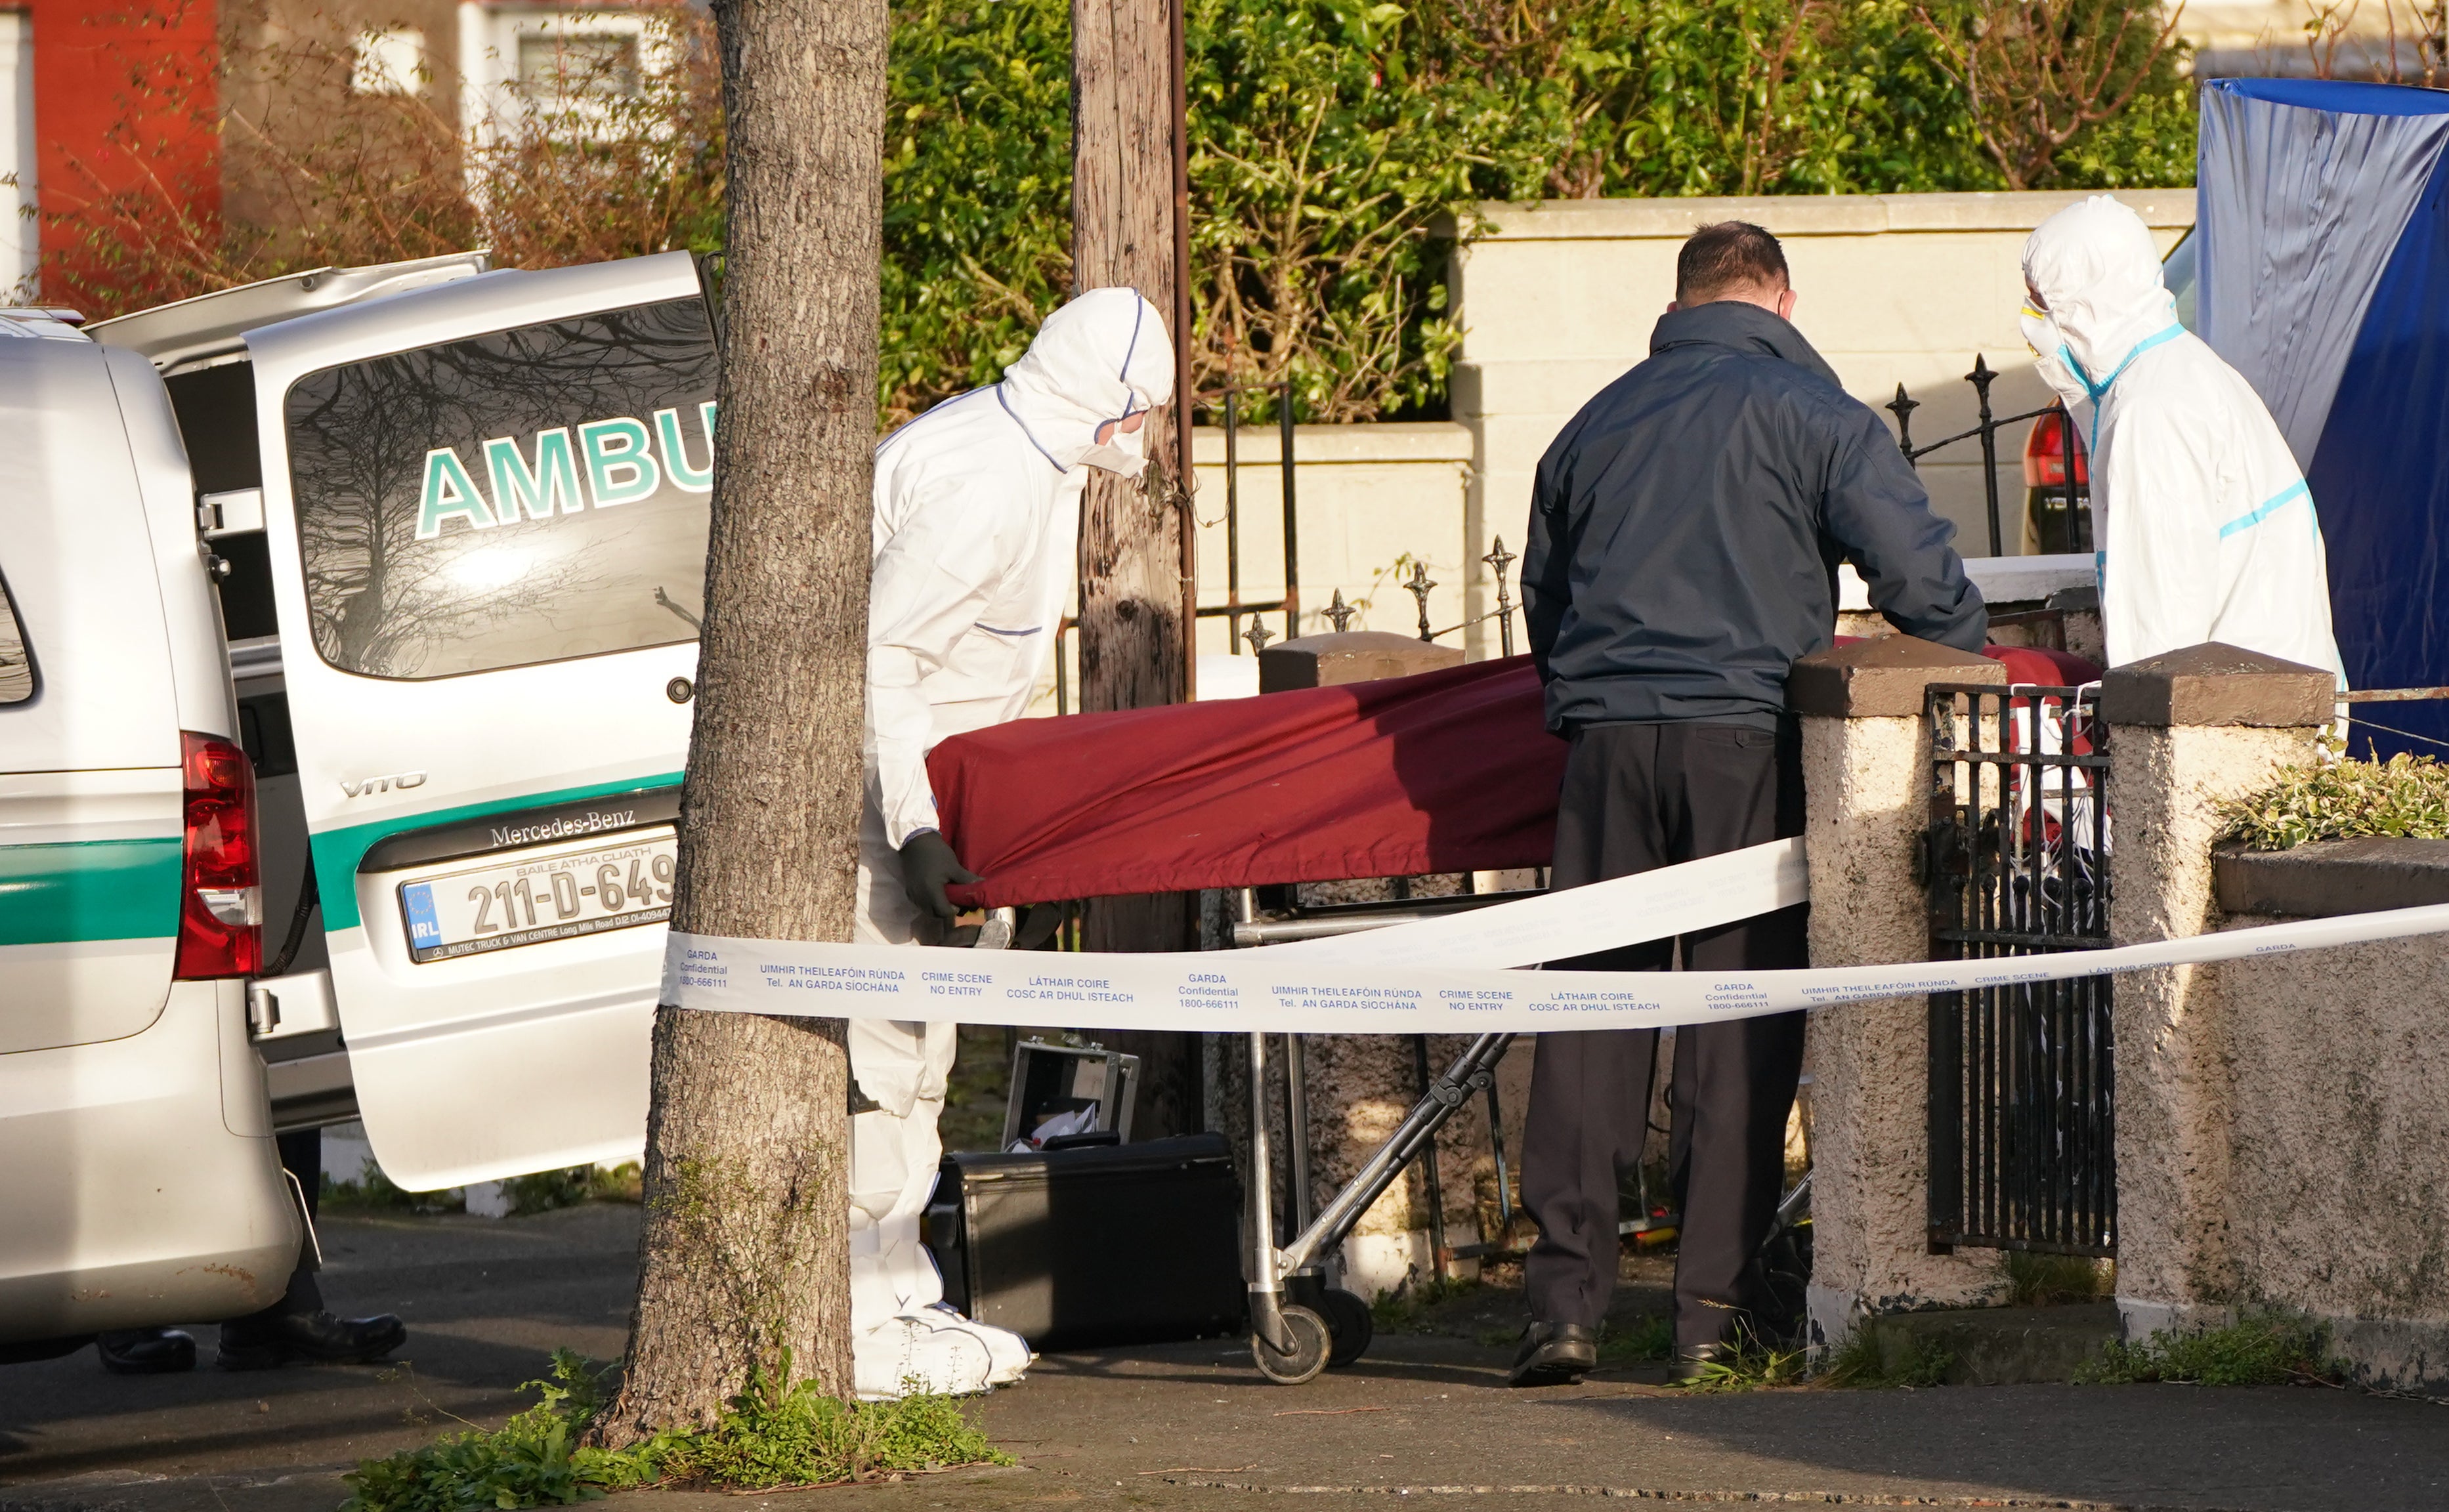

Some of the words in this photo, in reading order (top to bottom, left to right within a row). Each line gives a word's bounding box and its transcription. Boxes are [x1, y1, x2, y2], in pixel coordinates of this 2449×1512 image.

[414, 400, 717, 540] AMBU
[340, 770, 428, 797] VITO
[490, 810, 635, 847] Mercedes-Benz
[517, 862, 557, 877] BAILE
[603, 847, 652, 863] CLIATH
[469, 854, 675, 935] 211-D-649
[412, 921, 440, 939] IRL
[448, 942, 475, 955] MUTEC
[476, 938, 501, 951] TRUCK
[503, 936, 509, 946] &
[511, 933, 527, 944] VAN
[528, 927, 558, 940] CENTRE
[560, 926, 578, 935] Long
[579, 922, 594, 932] Mile
[595, 919, 613, 929] Road
[2256, 944, 2296, 952] GARDA
[687, 950, 717, 961] GARDA
[680, 962, 727, 975] Confidential
[760, 964, 796, 975] UIMHIR
[799, 966, 866, 978] THEILEAFÓIN
[869, 969, 905, 980] RÚNDA
[679, 976, 727, 988] 1800-666111
[922, 972, 954, 982] CRIME
[958, 974, 992, 984] SCENE
[1029, 976, 1074, 987] LÁTHAIR
[1077, 979, 1110, 989] COIRE
[1188, 974, 1227, 984] GARDA
[1974, 975, 2010, 983] CRIME
[2013, 972, 2051, 980] SCENE
[767, 978, 783, 987] Tel.
[788, 979, 803, 988] AN
[806, 980, 843, 990] GARDA
[845, 980, 899, 992] SÍOCHÁNA
[930, 985, 945, 994] NO
[948, 986, 983, 996] ENTRY
[1802, 986, 1839, 995] UIMHIR
[1843, 982, 1915, 992] THEILEAFÓIN
[1919, 978, 1958, 987] RÚNDA
[1007, 989, 1036, 999] COSC
[1039, 991, 1054, 1000] AR
[1057, 992, 1086, 1001] DHUL
[1088, 992, 1134, 1003] ISTEACH
[1178, 986, 1239, 997] Confidential
[1271, 986, 1308, 996] UIMHIR
[1311, 986, 1381, 998] THEILEAFÓIN
[1384, 988, 1422, 998] RÚNDA
[1439, 990, 1474, 999] CRIME
[1476, 991, 1513, 999] SCENE
[1551, 991, 1597, 1001] LÁTHAIR
[1600, 992, 1634, 1001] COIRE
[1705, 993, 1768, 1001] Confidential
[1180, 999, 1239, 1009] 1800-666111
[1279, 998, 1296, 1007] Tel.
[1302, 999, 1317, 1008] AN
[1320, 999, 1357, 1009] GARDA
[1361, 998, 1417, 1010] SÍOCHÁNA
[1468, 1002, 1503, 1011] ENTRY
[1581, 1003, 1610, 1011] DHUL
[1613, 1002, 1660, 1011] ISTEACH
[1708, 1001, 1769, 1010] 1800-666111
